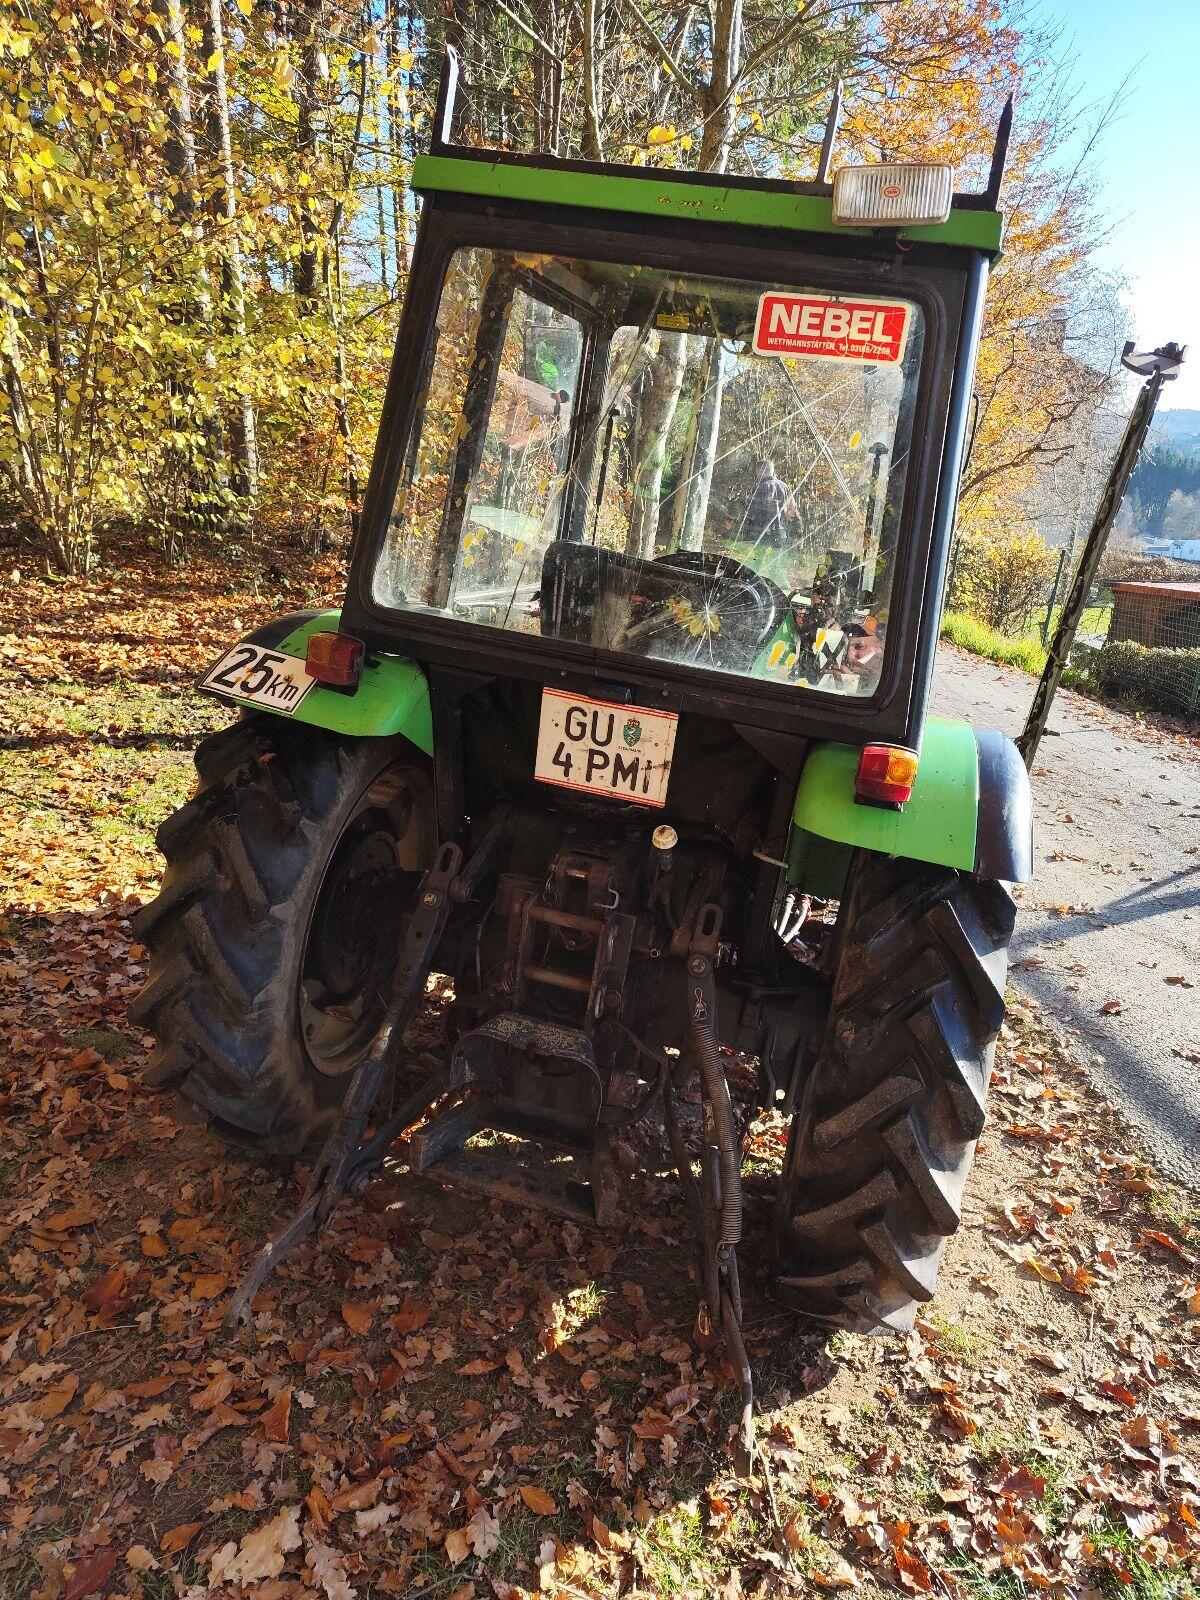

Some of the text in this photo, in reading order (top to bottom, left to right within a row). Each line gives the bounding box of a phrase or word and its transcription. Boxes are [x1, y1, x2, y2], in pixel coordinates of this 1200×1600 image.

[768, 303, 893, 343] NEBEL
[564, 706, 615, 747] GU
[552, 741, 574, 777] 4
